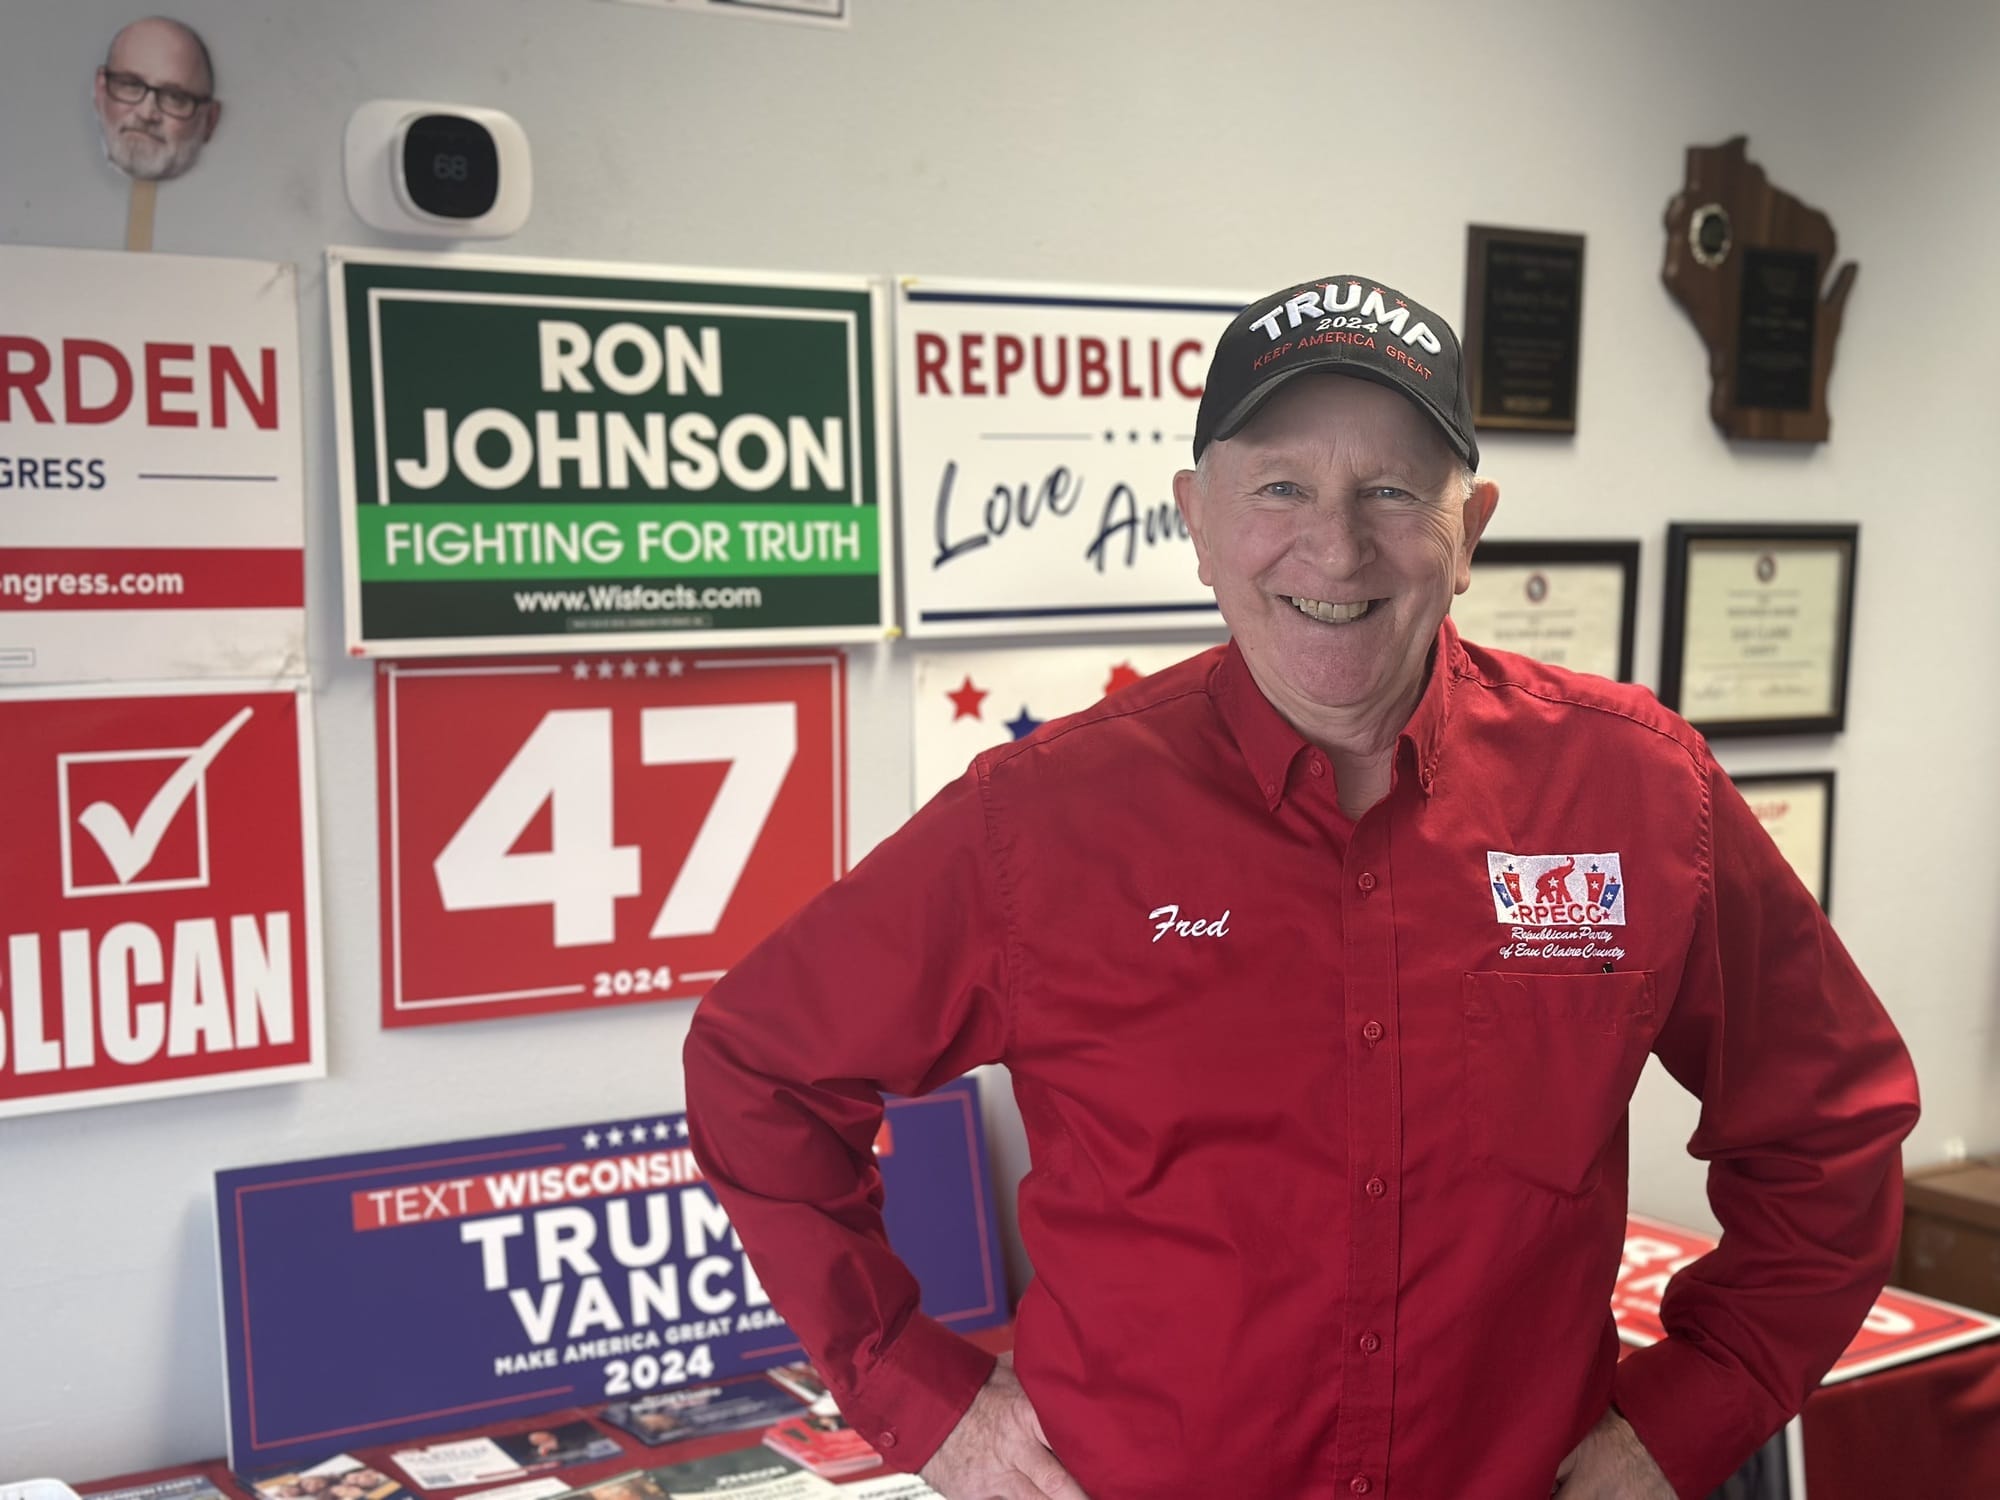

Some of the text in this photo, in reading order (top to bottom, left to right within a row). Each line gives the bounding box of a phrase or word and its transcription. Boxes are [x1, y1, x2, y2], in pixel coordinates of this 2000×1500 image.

[432, 152, 468, 181] 68
[1249, 284, 1441, 354] TRUMP
[1315, 316, 1378, 334] 2024
[538, 320, 723, 396] RON
[915, 332, 1204, 399] REPUBLIC
[1253, 331, 1433, 382] KEEP AMERICA GREAT
[395, 408, 845, 491] JOHNSON
[932, 460, 1085, 570] Love
[385, 521, 861, 566] FIGHTING FOR TRUTH
[0, 572, 184, 602] ngress.com
[514, 584, 762, 613] www.Wisfacts.com
[433, 702, 798, 948] 47
[1149, 904, 1231, 943] Fred
[1511, 927, 1613, 942] Republican Party
[1518, 903, 1602, 924] RPECC
[1499, 943, 1625, 960] of Eau Claire County
[0, 910, 294, 1075] LICAN
[592, 965, 672, 997] 2024
[368, 1179, 475, 1227] TEXT
[460, 1187, 744, 1292] TRUM
[495, 1348, 558, 1376] MAKE
[563, 1330, 661, 1365] AMERICA
[664, 1315, 733, 1346] GREAT
[604, 1345, 714, 1397] 2024
